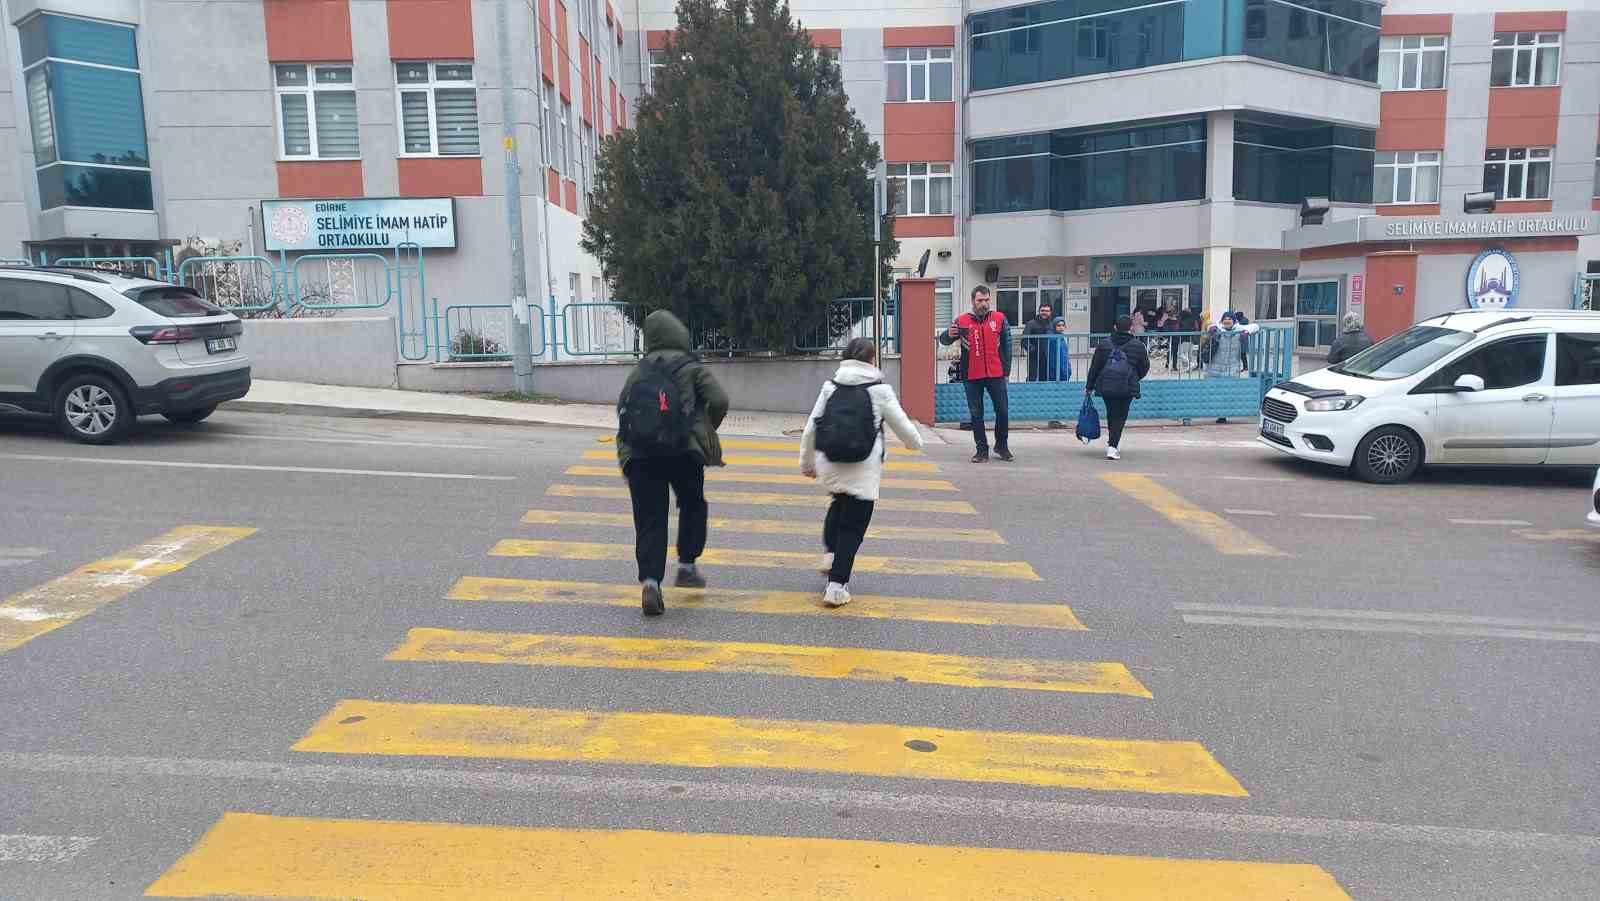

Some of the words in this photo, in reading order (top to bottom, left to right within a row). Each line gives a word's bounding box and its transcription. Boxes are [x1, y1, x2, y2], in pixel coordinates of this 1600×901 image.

[315, 202, 347, 213] EDİRNE
[316, 214, 373, 231] SELİMİYE
[376, 213, 410, 230] İMAM
[413, 212, 448, 230] HATİP
[1386, 218, 1441, 236] SELİMİYE
[1445, 217, 1478, 235] İMAM
[1481, 217, 1514, 234] HATİP
[1518, 215, 1588, 233] ORTAOKULU
[318, 232, 390, 247] ORTAOKULU
